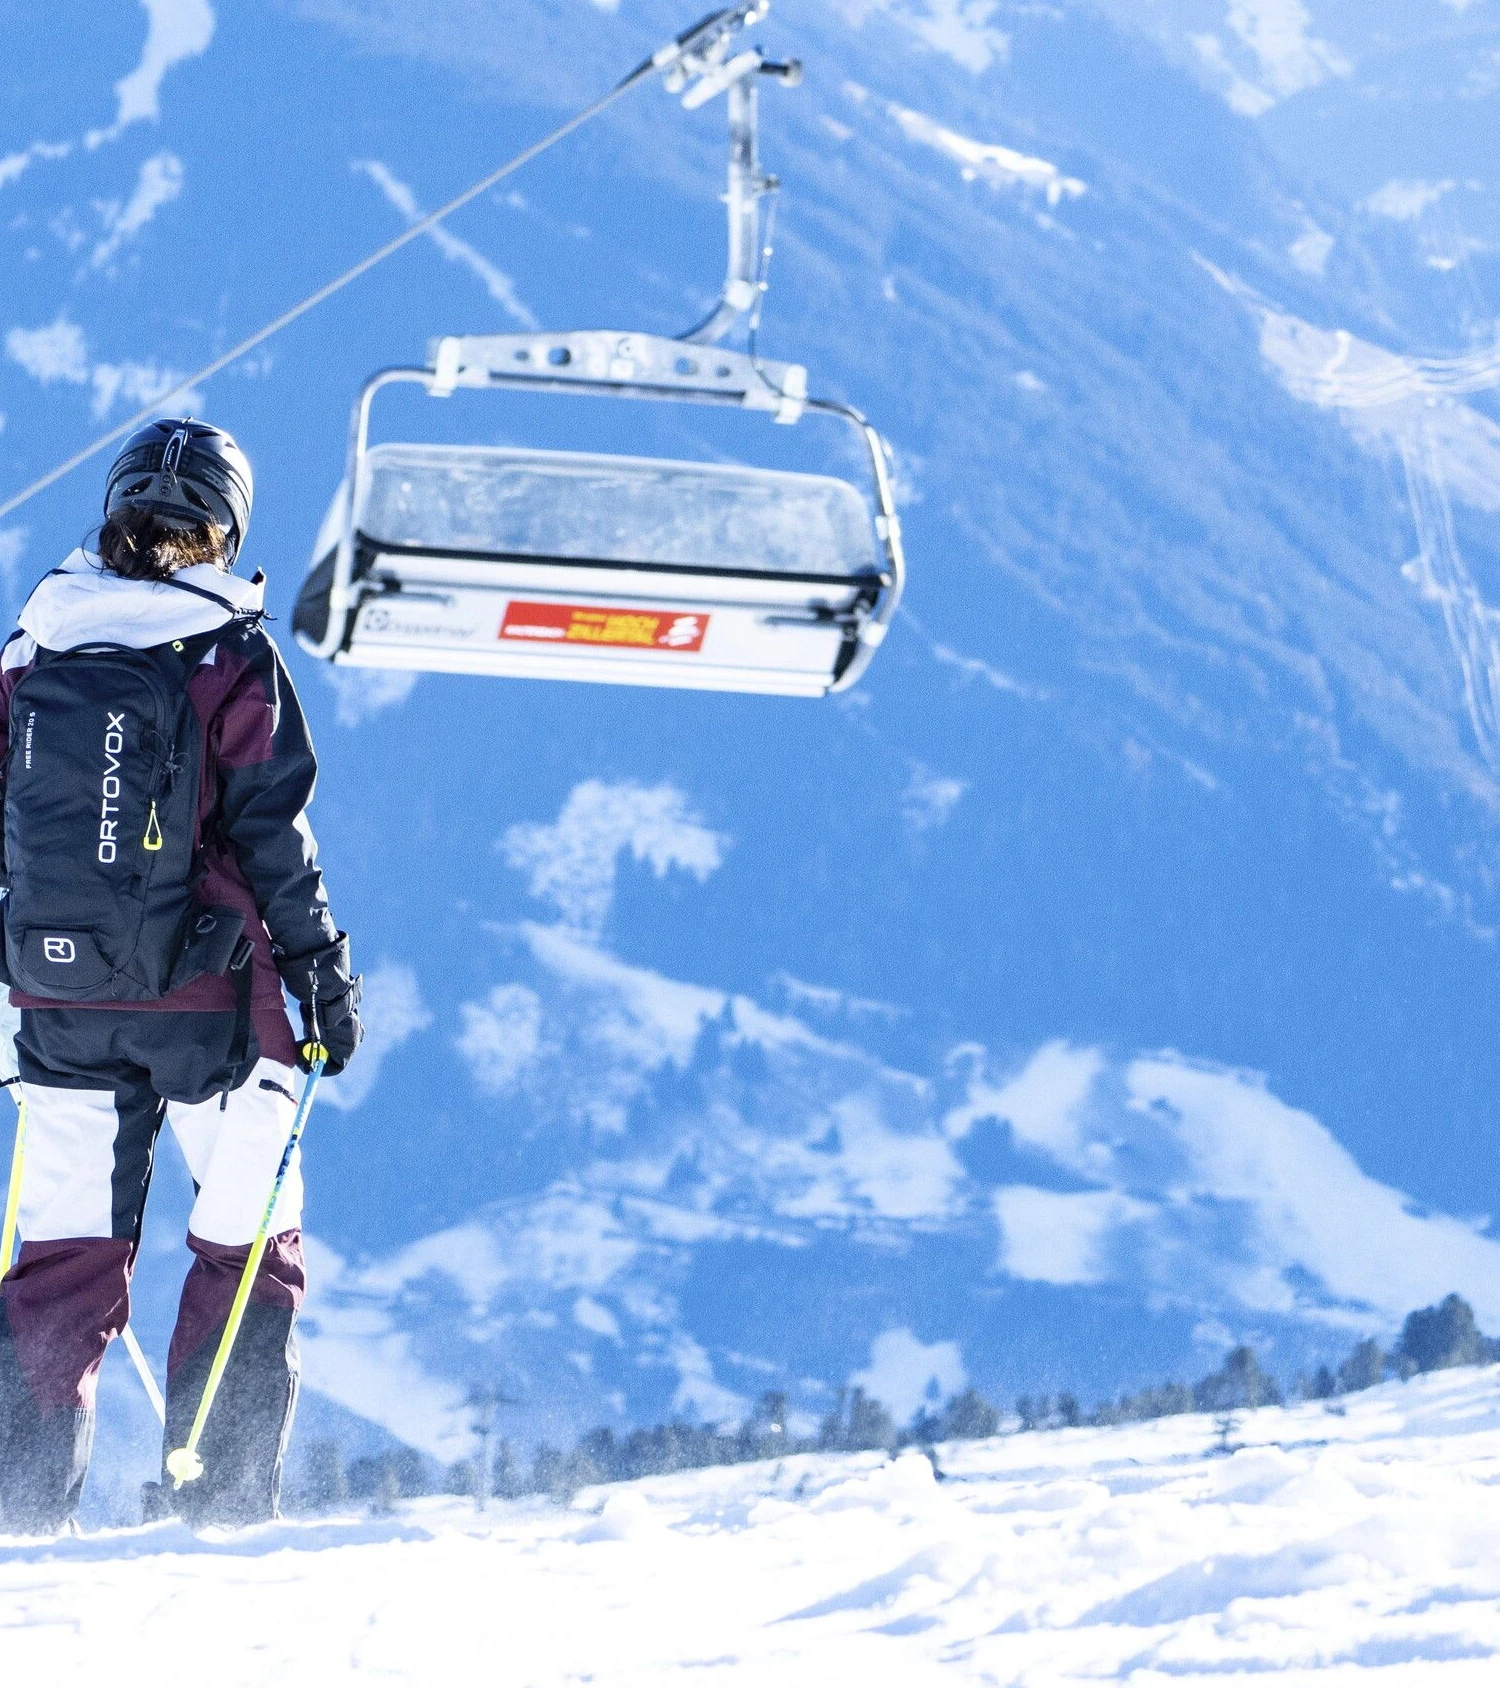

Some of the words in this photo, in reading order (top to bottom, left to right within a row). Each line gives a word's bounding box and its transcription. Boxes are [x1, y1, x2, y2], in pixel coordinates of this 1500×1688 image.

[28, 718, 35, 727] 20
[25, 727, 33, 749] RIDER
[98, 711, 125, 863] ORTOVOX
